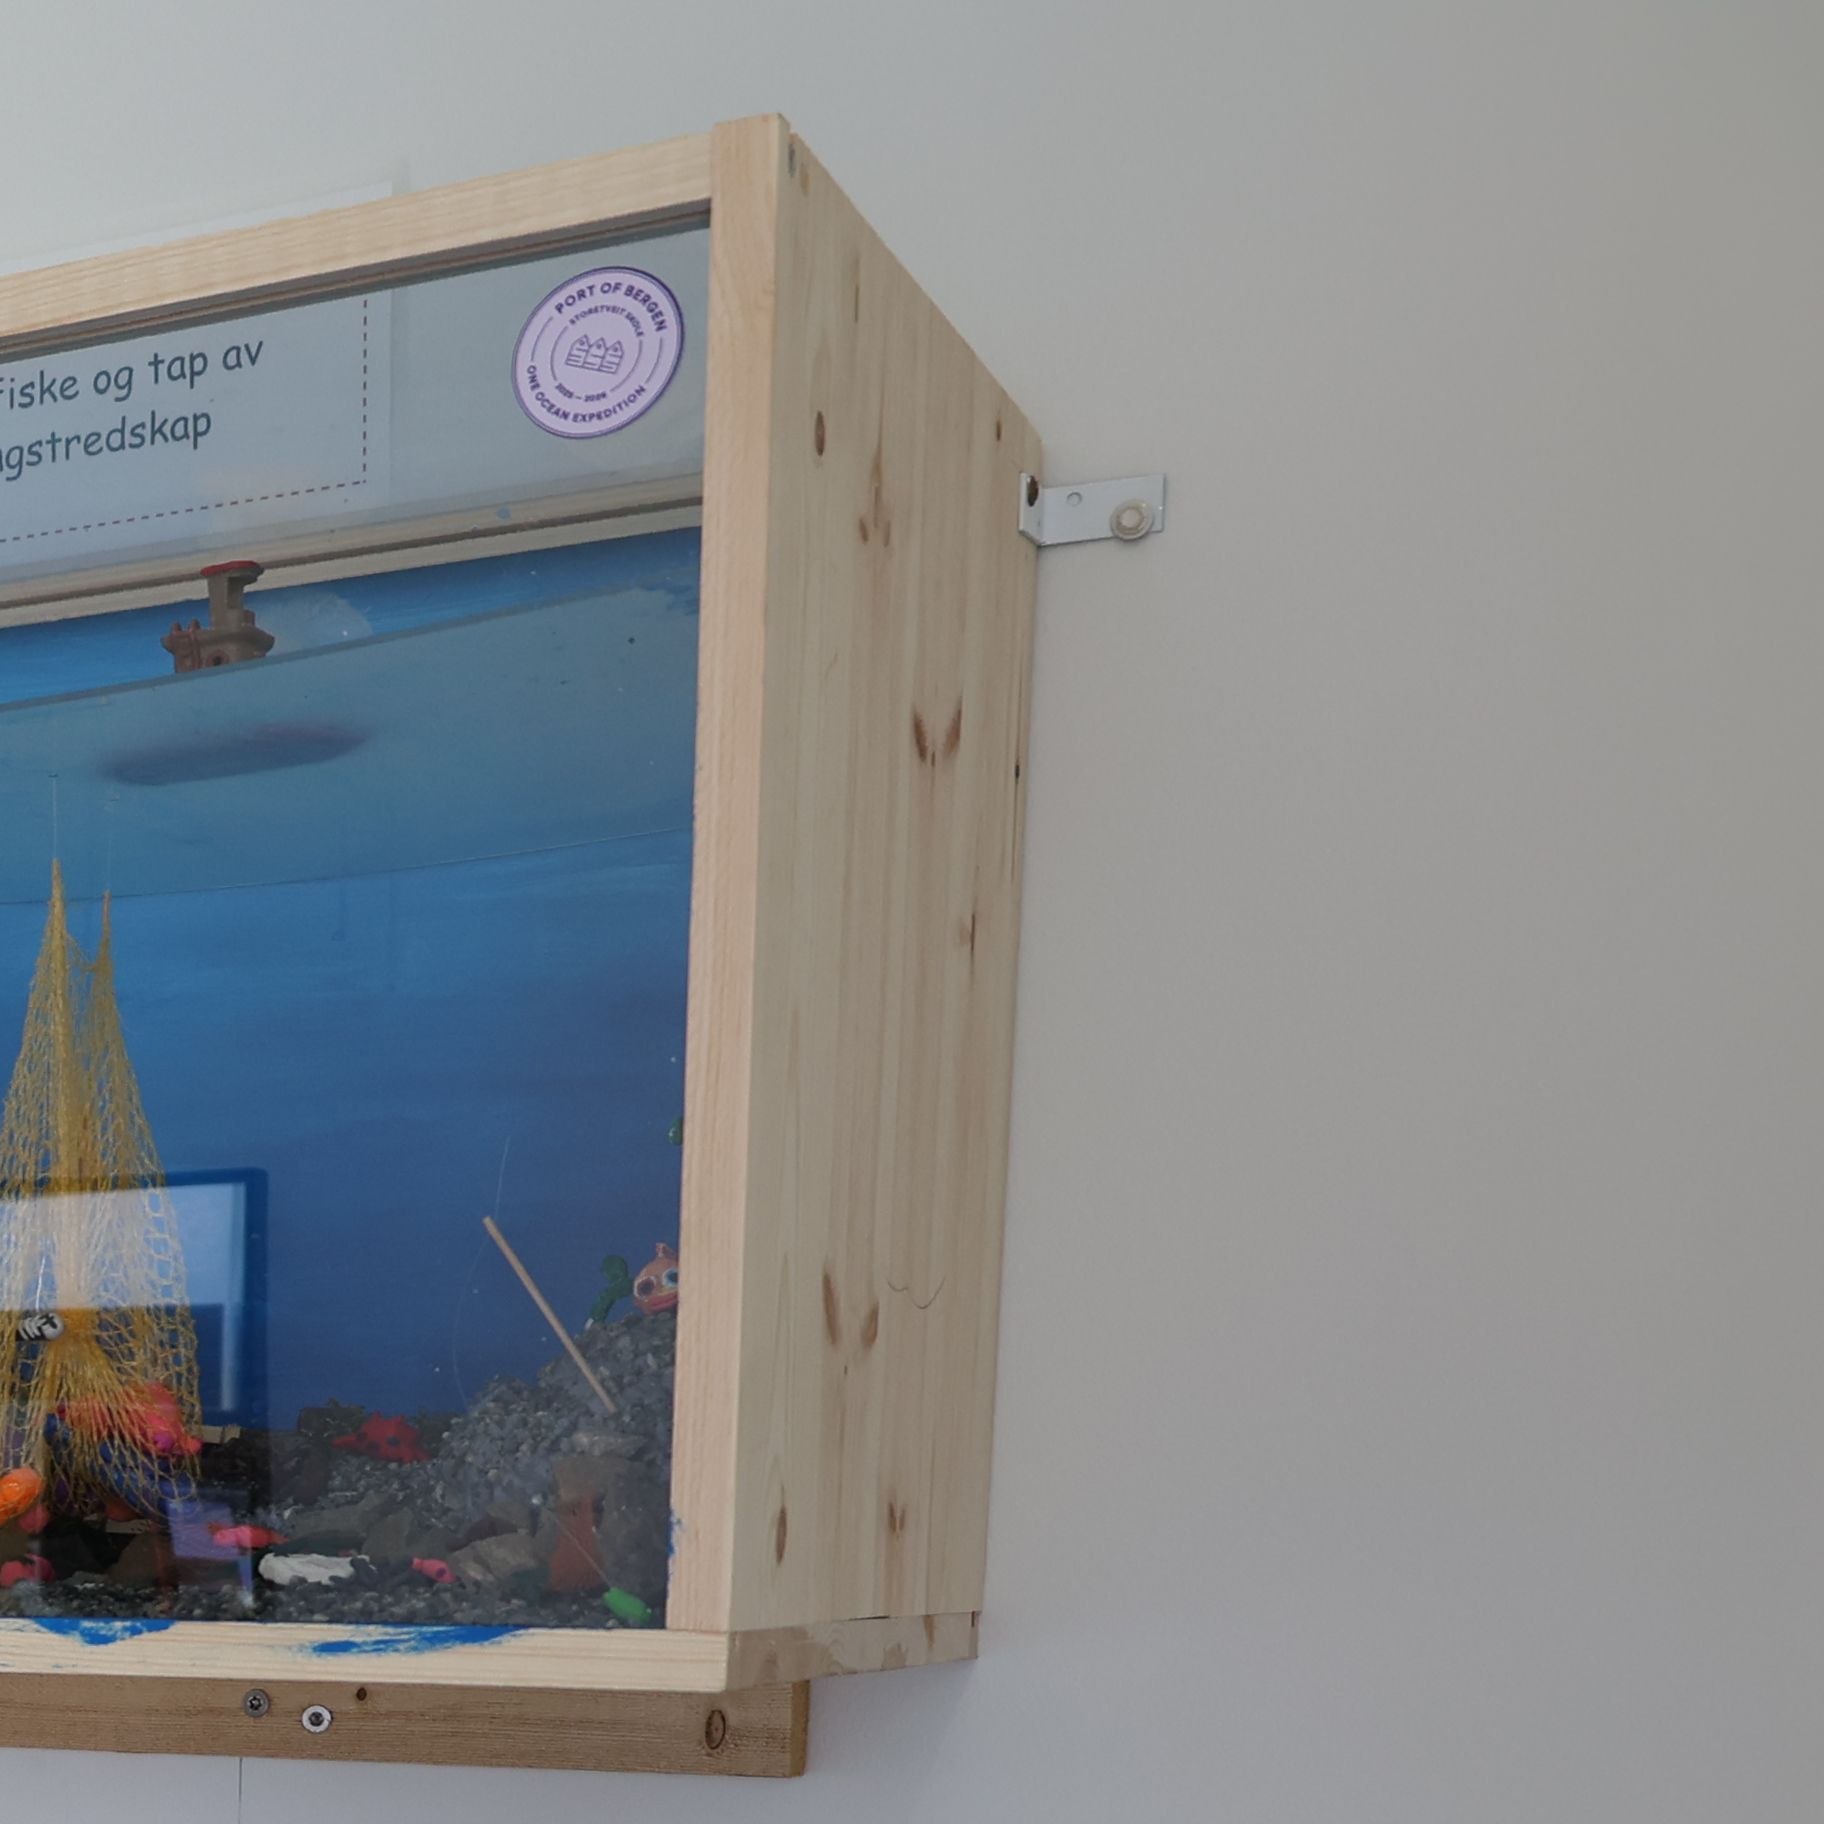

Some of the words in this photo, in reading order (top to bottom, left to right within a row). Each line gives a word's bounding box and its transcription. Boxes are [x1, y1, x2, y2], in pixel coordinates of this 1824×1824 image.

[555, 284, 596, 315] PORT
[599, 281, 623, 295] OF
[623, 284, 668, 332] BERGEN
[92, 365, 135, 403] og
[147, 347, 210, 390] tap
[222, 339, 264, 372] av
[526, 364, 541, 392] ONE
[535, 390, 571, 421] OCEAN
[572, 384, 646, 423] EXPEDITION
